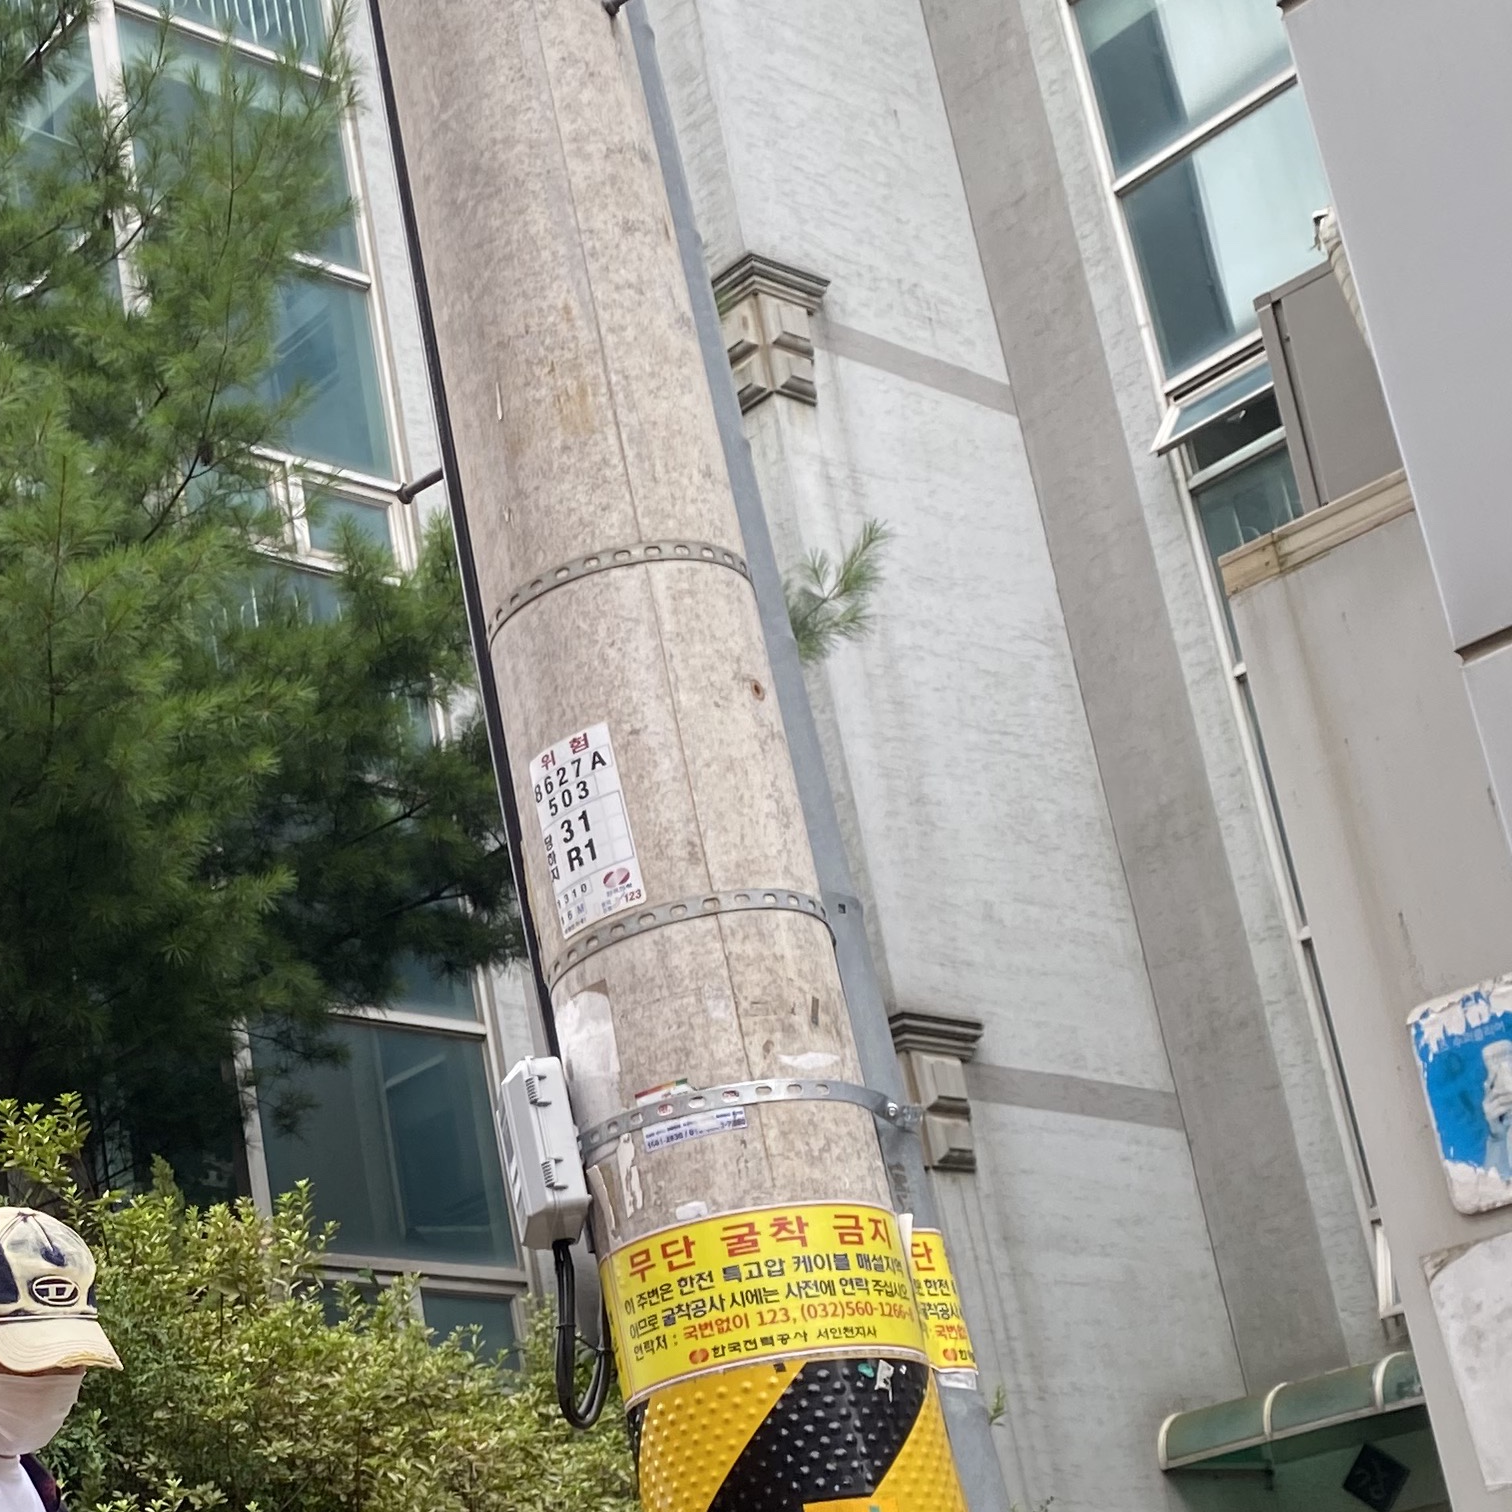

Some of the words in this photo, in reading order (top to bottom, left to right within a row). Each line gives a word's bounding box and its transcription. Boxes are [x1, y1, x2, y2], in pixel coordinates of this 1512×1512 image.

[548, 781, 589, 816] 503
[561, 810, 591, 843] 31
[567, 838, 597, 871] R1
[624, 889, 642, 903] 123
[629, 1235, 696, 1283] 무단
[720, 1215, 809, 1257] 굴착
[833, 1214, 892, 1249] 금지
[637, 1283, 674, 1310] 주변은
[677, 1270, 715, 1296] 한전
[722, 1258, 785, 1282] 특고압
[792, 1253, 850, 1273] 케이블
[856, 1253, 905, 1277] 매설지역
[629, 1314, 660, 1339] 이므로
[662, 1294, 725, 1326] 굴착공사
[729, 1287, 780, 1309] 시에는
[785, 1279, 836, 1299] 사전에
[839, 1277, 869, 1296] 연락
[872, 1280, 911, 1301] 주십시오
[683, 1312, 750, 1341] 국번없이
[711, 1329, 808, 1358] 한국전력공사
[816, 1326, 878, 1340] 서인천지사
